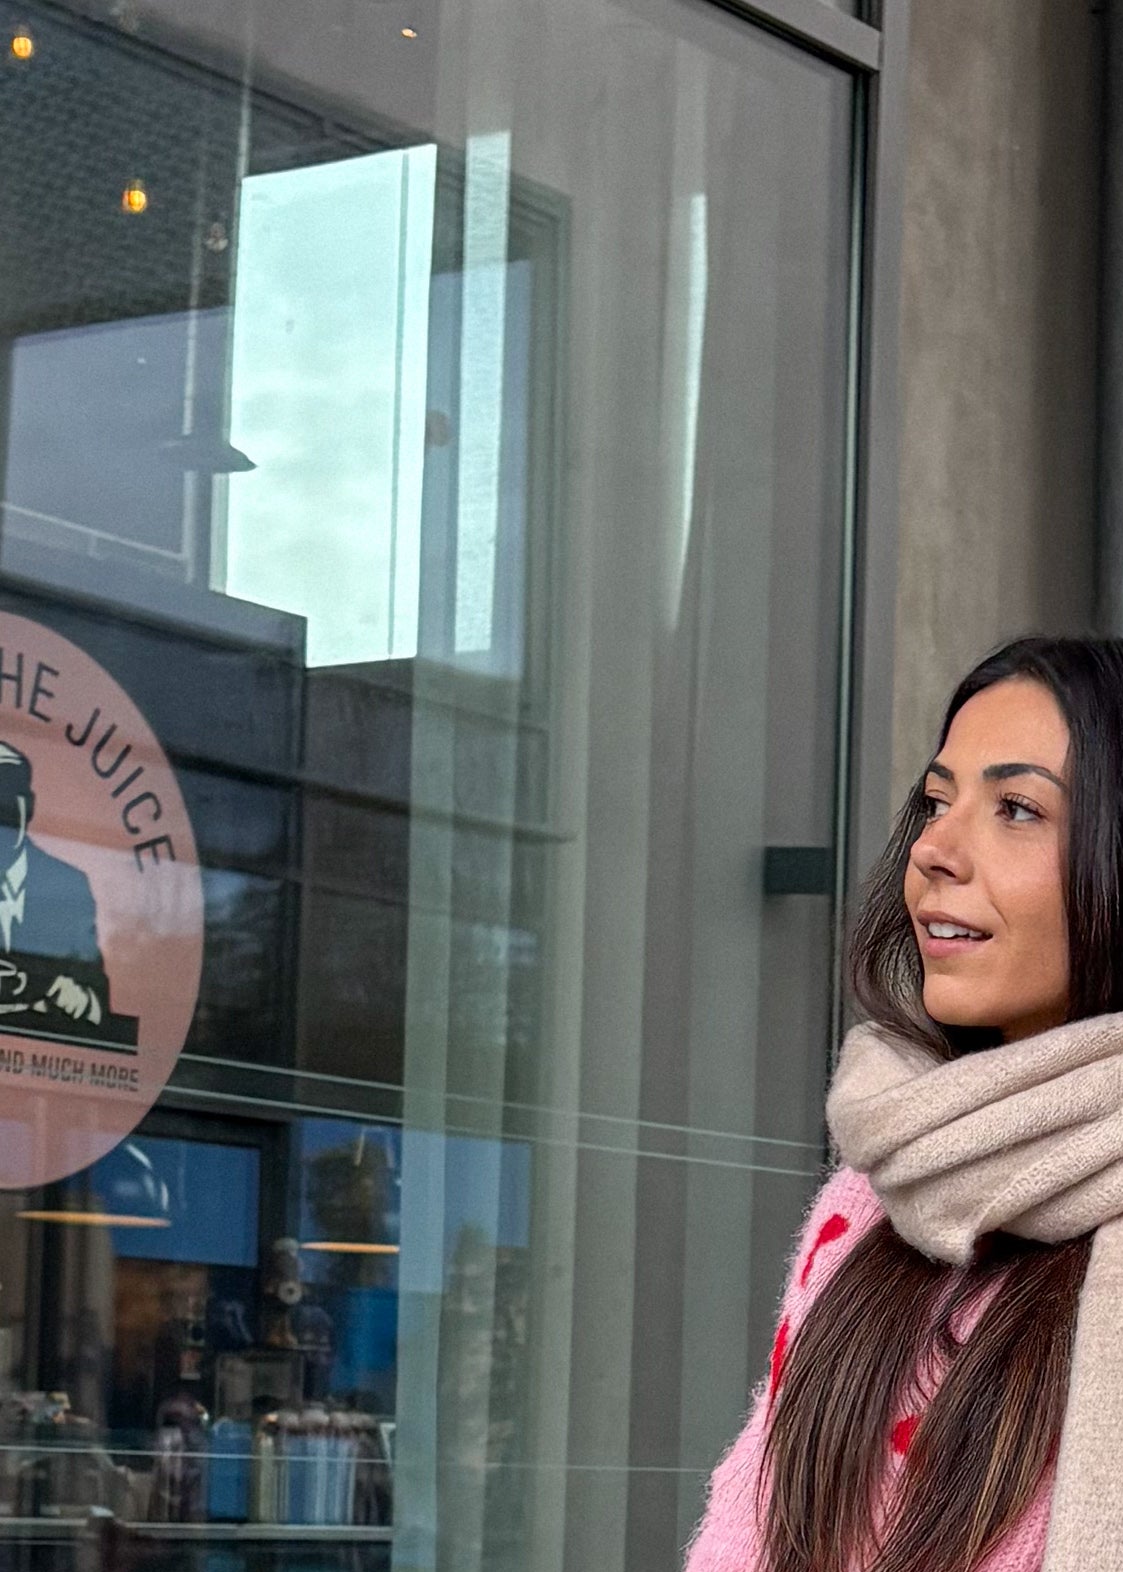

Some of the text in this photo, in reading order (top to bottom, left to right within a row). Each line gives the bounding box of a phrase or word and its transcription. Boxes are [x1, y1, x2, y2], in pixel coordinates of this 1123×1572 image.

[65, 708, 176, 874] JUICE
[31, 1053, 84, 1085] MUCH
[90, 1062, 139, 1092] MORE
